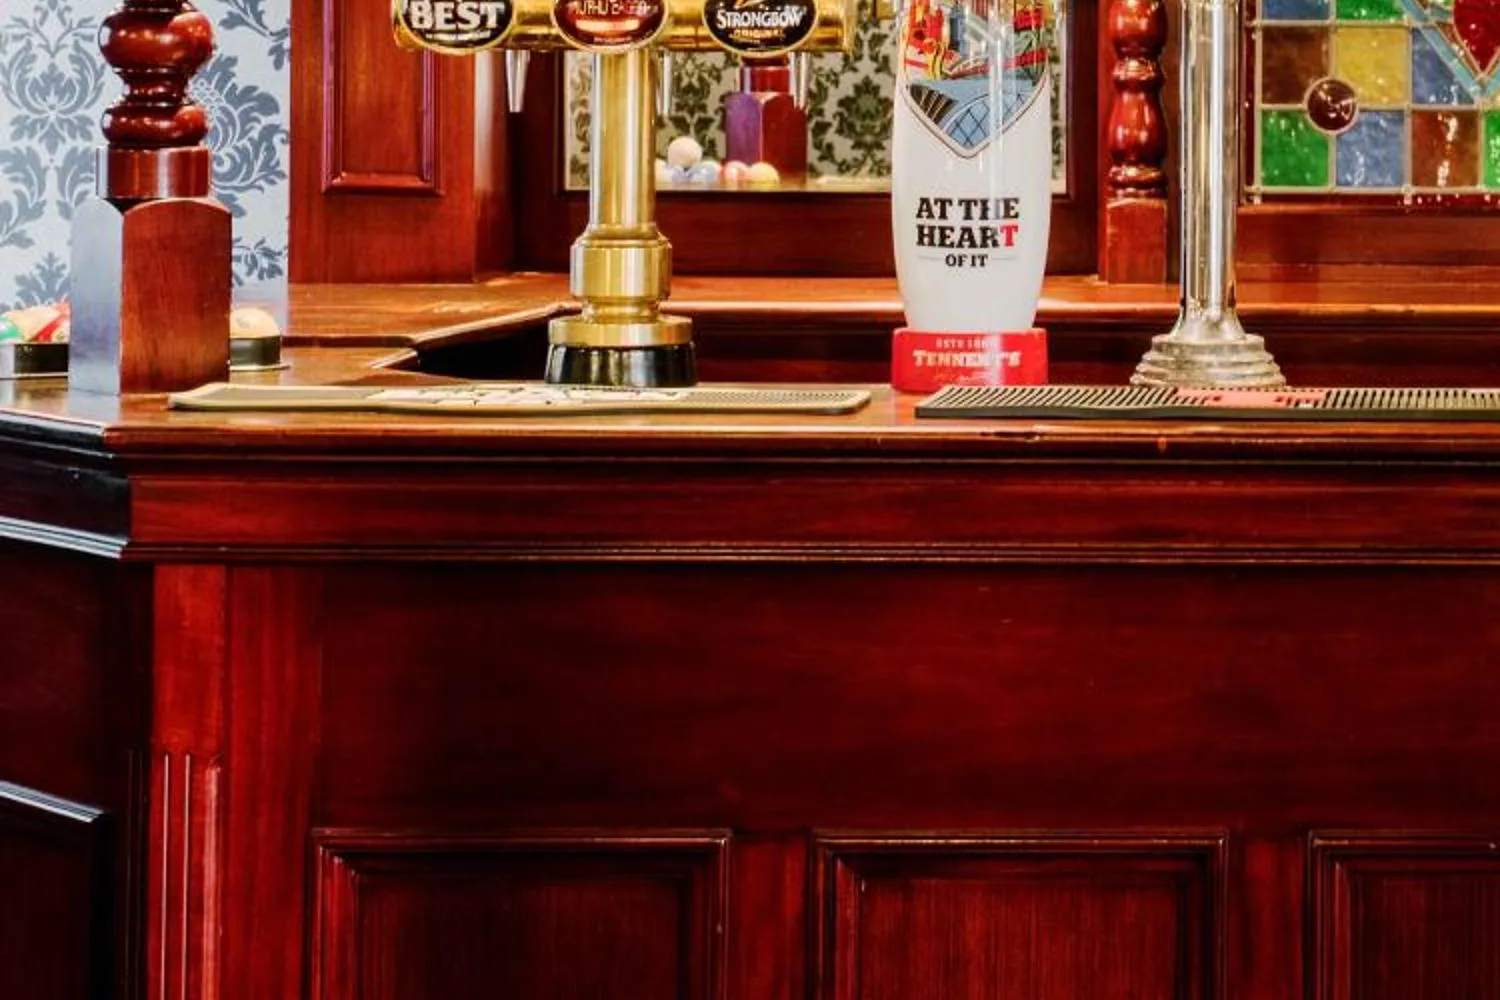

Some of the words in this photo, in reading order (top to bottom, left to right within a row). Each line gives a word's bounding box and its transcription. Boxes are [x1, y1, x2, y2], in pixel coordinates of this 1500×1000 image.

[410, 0, 505, 31] BEST
[716, 4, 807, 29] STRONGBOW
[915, 197, 953, 221] AT
[957, 197, 1019, 221] THE
[916, 223, 1019, 249] HEART
[945, 253, 967, 267] OF
[970, 254, 988, 267] IT
[912, 350, 1022, 368] TENNENT'S
